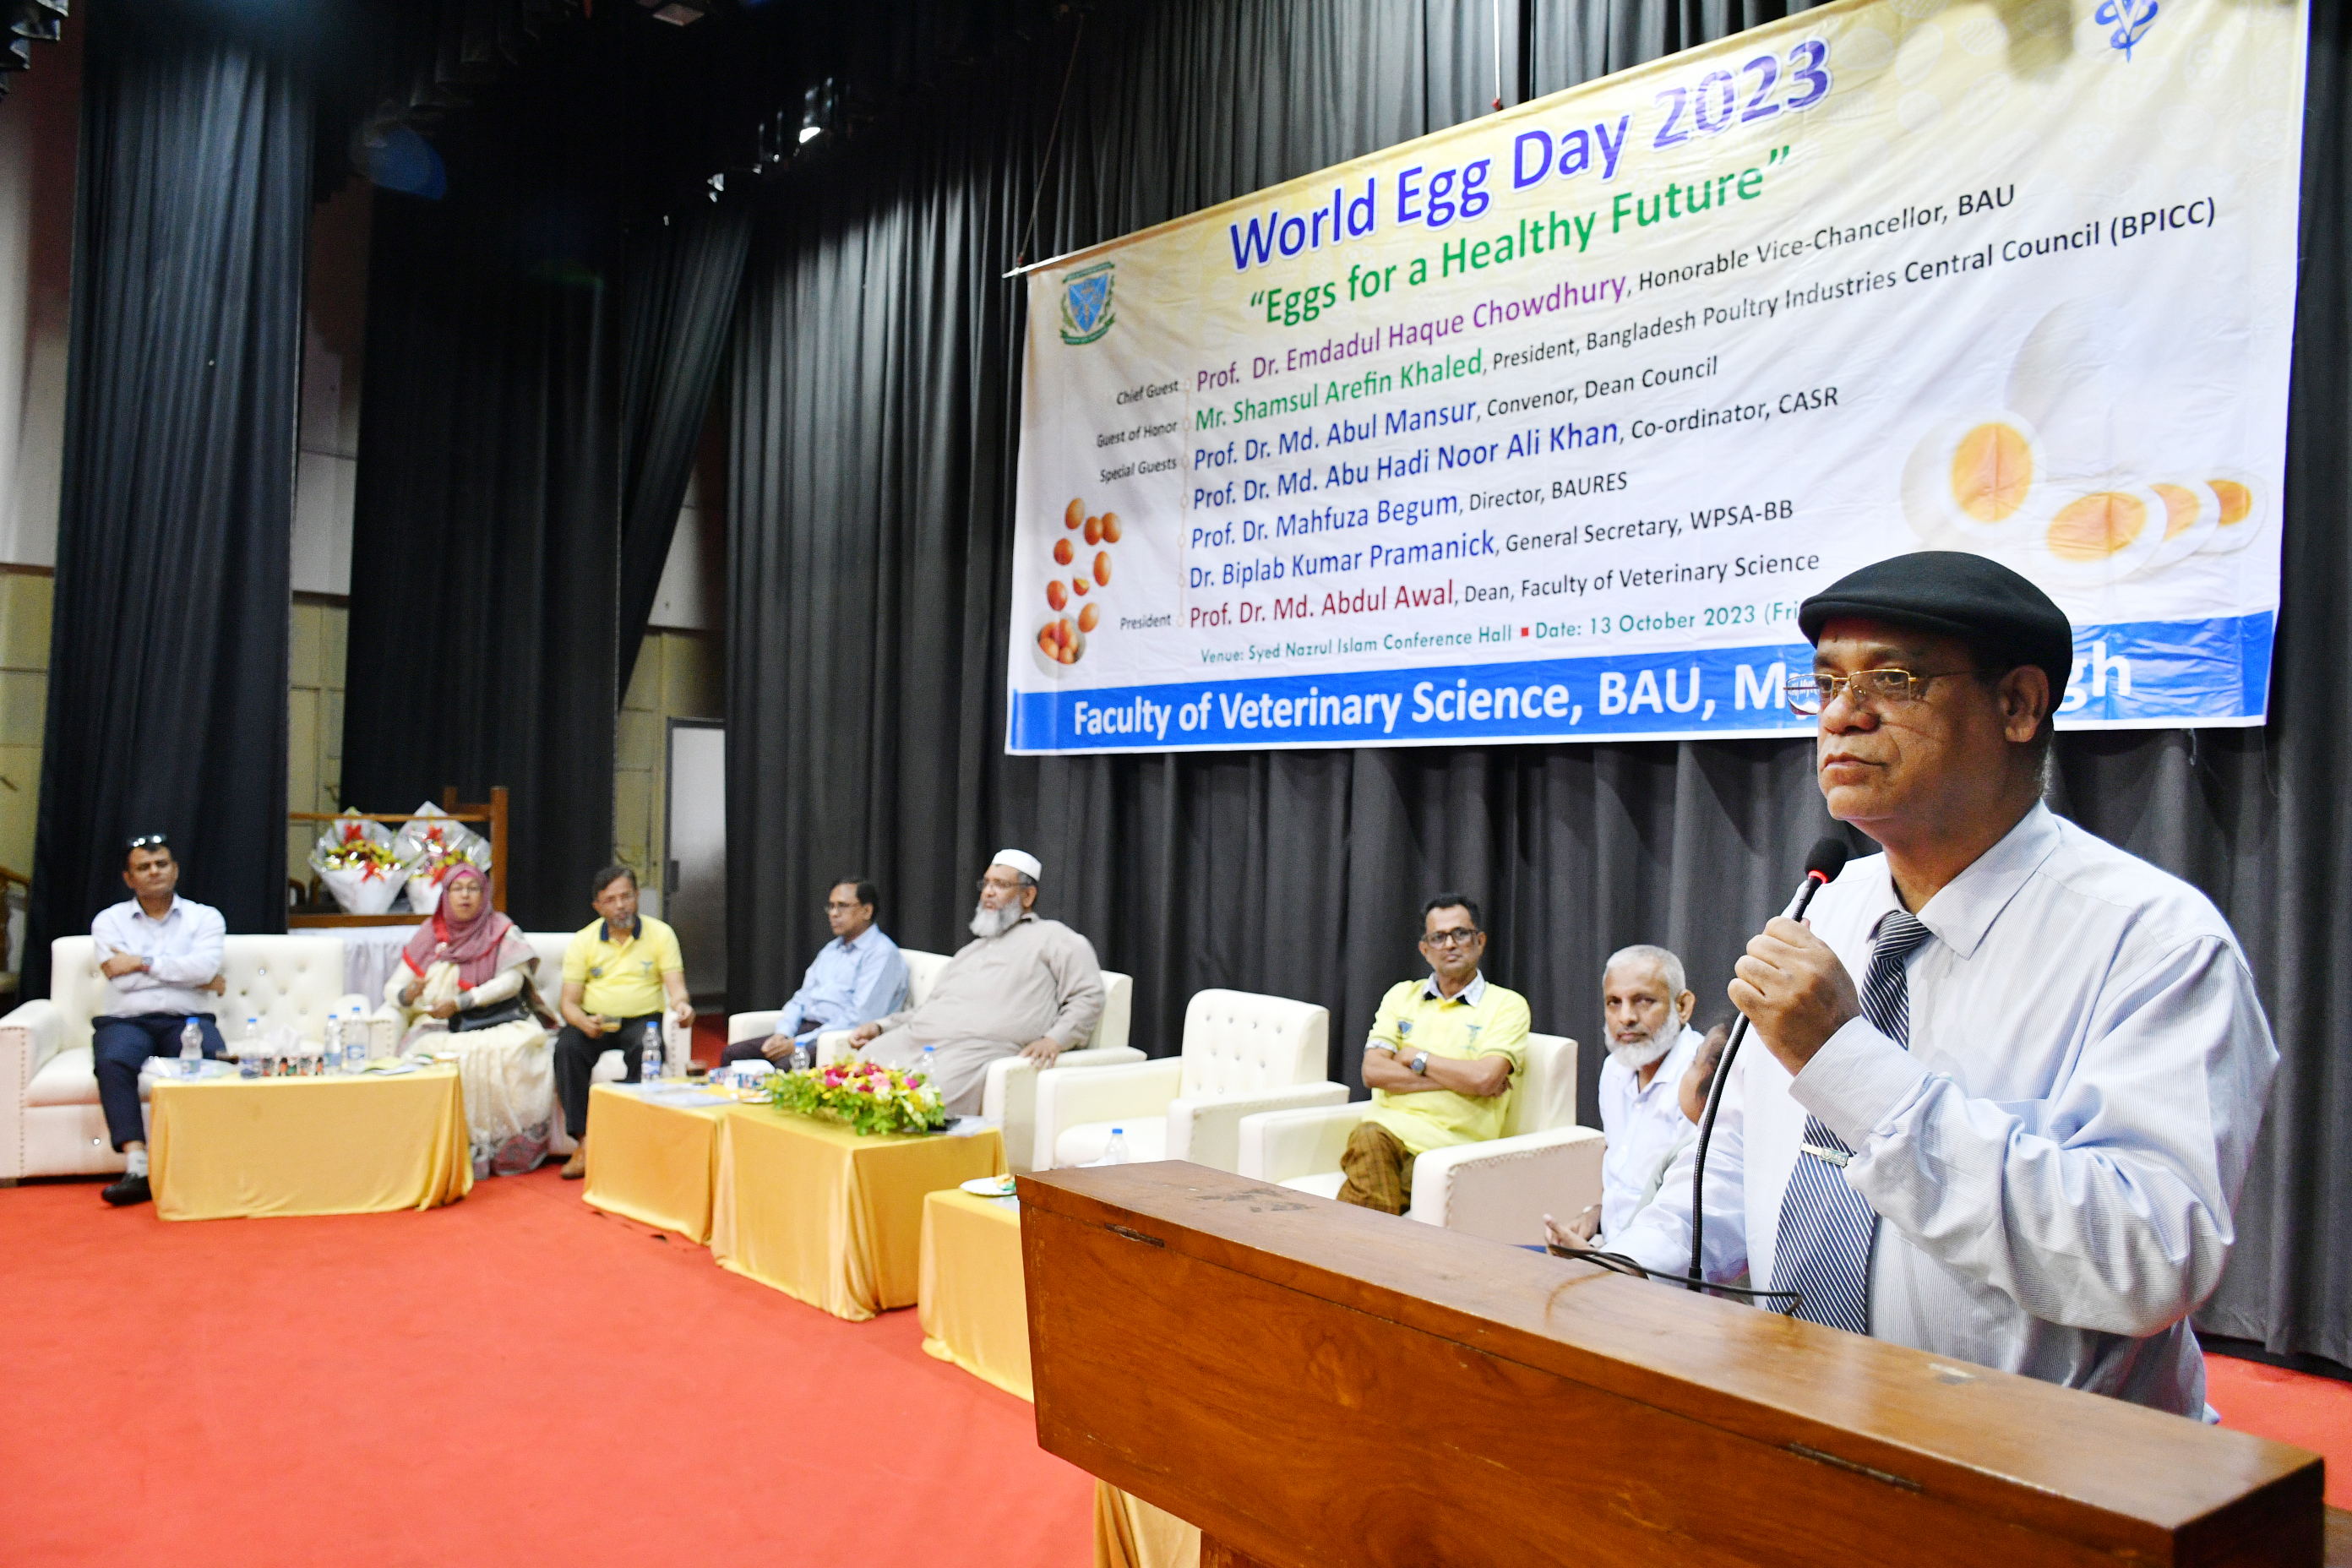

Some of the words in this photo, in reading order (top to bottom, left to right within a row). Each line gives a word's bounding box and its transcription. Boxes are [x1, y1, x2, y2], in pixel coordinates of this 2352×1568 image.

[1229, 177, 1375, 270] World
[1397, 158, 1491, 227] Egg
[1513, 114, 1630, 190] Day
[1652, 39, 1832, 149] 2023
[1250, 280, 1337, 327] “Eggs
[1347, 264, 1398, 302] for
[1407, 257, 1428, 286] a
[1441, 210, 1597, 279] Healthy
[1611, 144, 1791, 235] Future”
[1195, 406, 1227, 432] Mr.
[1233, 383, 1319, 424] Shamsul
[1324, 370, 1392, 406] Arefin
[1400, 347, 1488, 389] Khaled,
[1493, 338, 1581, 371] President,
[1587, 310, 1696, 351] Bangladesh
[1703, 297, 1779, 327] Poultry
[1785, 270, 1897, 309] Industries
[1904, 242, 1993, 283] Central
[2001, 220, 2100, 263] Council
[2110, 196, 2216, 248] (BPICC)
[1196, 361, 1240, 393] Prof.
[1253, 357, 1279, 379] Dr.
[1287, 326, 1380, 372] Emdadul
[1388, 314, 1464, 349] Haque
[1473, 275, 1631, 329] Chowdhury,
[1639, 249, 1750, 291] Honorable
[1756, 204, 1948, 264] Vice-Chancellor,
[1957, 183, 2015, 217] BAU
[1115, 385, 1144, 406] Chief
[1145, 379, 1179, 399] Guest
[1194, 440, 1238, 471] Prof.
[1244, 438, 1271, 462] Dr.
[1278, 425, 1320, 456] Md.
[1326, 412, 1377, 447] Abul
[1385, 400, 1481, 436] Mansur,
[1487, 387, 1578, 417] Convenor,
[1585, 376, 1635, 400] Dean
[1642, 354, 1718, 389] Council
[1096, 429, 1126, 449] Guest
[1127, 425, 1143, 442] of
[1142, 421, 1179, 439] Honor
[1099, 461, 1136, 486] Special
[1137, 456, 1179, 476] Guests
[1193, 480, 1237, 510] Prof.
[1244, 478, 1270, 503] Dr.
[1277, 467, 1319, 497] Md.
[1324, 460, 1369, 489] Abu
[1376, 448, 1429, 481] Hadi
[1437, 442, 1500, 471] Noor
[1505, 427, 1541, 460] Ali
[1549, 422, 1625, 453] Khan,
[1631, 402, 1771, 439] Co-ordinator,
[1778, 386, 1839, 415] CASR
[1190, 566, 1215, 589] Dr.
[1222, 555, 1285, 589] Biplab
[1292, 552, 1364, 578] Kumar
[1369, 528, 1500, 569] Pramanick,
[1505, 525, 1578, 553] General
[1583, 518, 1683, 543] Secretary,
[1690, 499, 1794, 531] WPSA-BB
[1191, 520, 1236, 549] Prof.
[1243, 520, 1269, 543] Dr.
[1276, 505, 1369, 538] Mahfuza
[1377, 495, 1464, 526] Begum,
[1469, 487, 1545, 511] Director,
[1552, 471, 1628, 500] BAURES
[1119, 613, 1172, 630] President
[1190, 602, 1232, 629] Prof.
[1239, 601, 1266, 624] Dr.
[1273, 594, 1315, 621] Md.
[1320, 585, 1387, 617] Abdul
[1394, 578, 1459, 610] Awal,
[1464, 585, 1515, 603] Dean,
[1522, 574, 1588, 597] Faculty
[1593, 569, 1614, 591] of
[1619, 563, 1729, 588] Veterinary
[1734, 554, 1820, 578] Science
[1200, 649, 1244, 664] Venue:
[1248, 642, 1282, 663] Syed
[1285, 639, 1332, 658] Nazrul
[1337, 636, 1378, 655] Islam
[1383, 631, 1473, 651] Conference
[1478, 623, 1512, 644] Hall
[1535, 621, 1582, 640] Date:
[1591, 616, 1612, 635] 13
[1619, 611, 1696, 634] October
[1703, 604, 1756, 627] 2023
[1074, 695, 1173, 741] Faculty
[1179, 691, 1213, 732] of
[1218, 686, 1403, 734] Veterinary
[1411, 678, 1585, 727] Science,
[1598, 662, 1717, 721] BAU,
